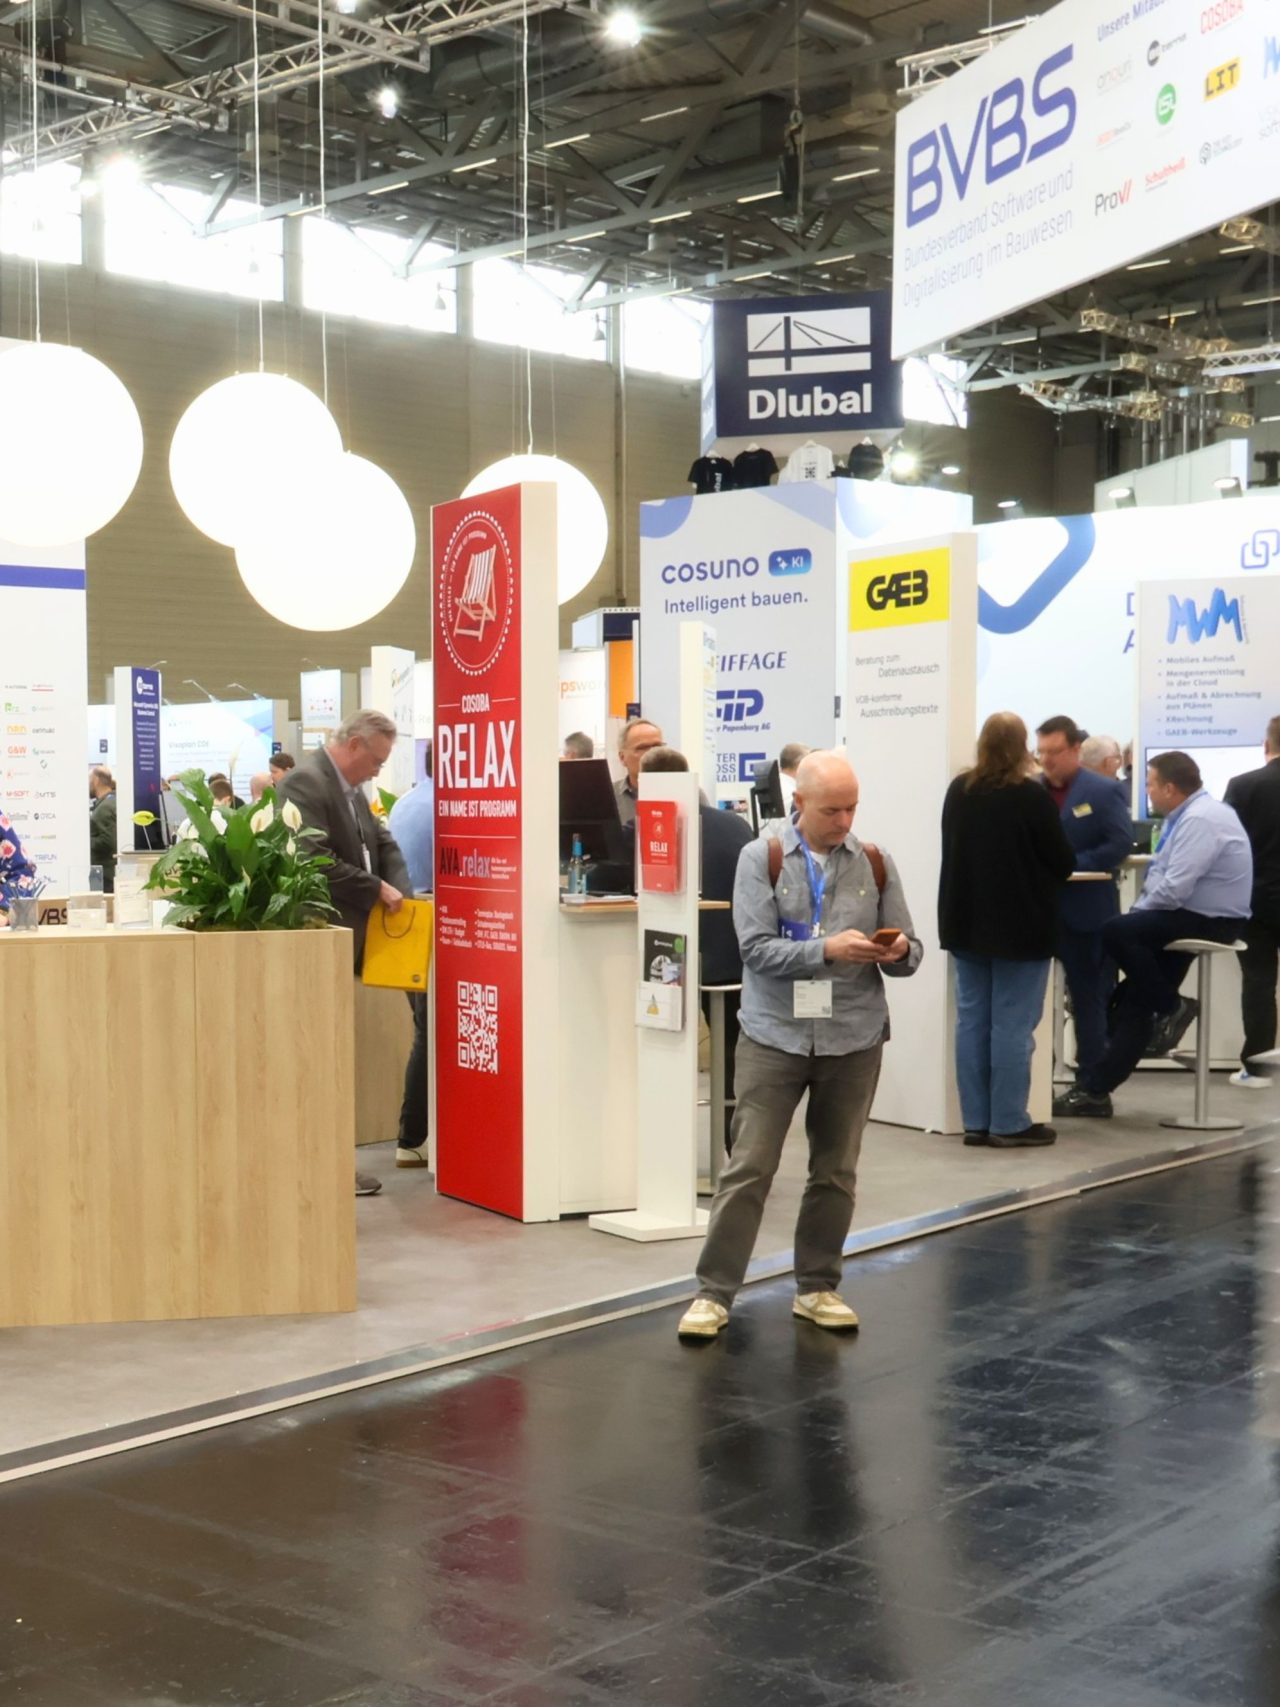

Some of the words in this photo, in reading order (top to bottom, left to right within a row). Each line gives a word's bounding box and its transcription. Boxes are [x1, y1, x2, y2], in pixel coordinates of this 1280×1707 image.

[1205, 63, 1238, 97] LIT
[907, 43, 1077, 228] BVBS
[904, 207, 987, 272] Bundesverband
[991, 181, 1045, 227] Software
[1048, 161, 1073, 199] und
[903, 252, 983, 308] Digitalisierung
[986, 243, 1001, 266] im
[1005, 208, 1073, 259] Bauwesen
[748, 382, 872, 420] Dlubal
[661, 556, 760, 584] cosuno
[791, 555, 804, 568] KI
[866, 569, 929, 611] GAEB
[664, 594, 746, 615] Intelligent
[751, 591, 809, 607] bauen.
[1167, 587, 1243, 644] MWM
[855, 655, 884, 667] Beratung
[886, 653, 900, 663] zum
[1166, 656, 1199, 664] Mobiles
[1202, 655, 1235, 663] Aufmaß
[878, 663, 940, 678] Datenaustausch
[1166, 668, 1245, 679] Mengenermittlung
[1166, 679, 1174, 687] in
[1177, 679, 1191, 687] der
[1194, 679, 1218, 687] Cloud
[462, 693, 490, 714] COSOBA
[1166, 692, 1199, 700] Aufmaß
[1210, 690, 1262, 700] Abrechnung
[860, 704, 939, 719] Ausschreibungstexte
[1183, 701, 1213, 710] Plänen
[438, 720, 517, 789] RELAX
[439, 800, 449, 817] EIN
[450, 800, 468, 817] NAME
[468, 800, 479, 817] IST
[479, 800, 517, 817] PROGRAMM
[650, 840, 668, 854] RELAX
